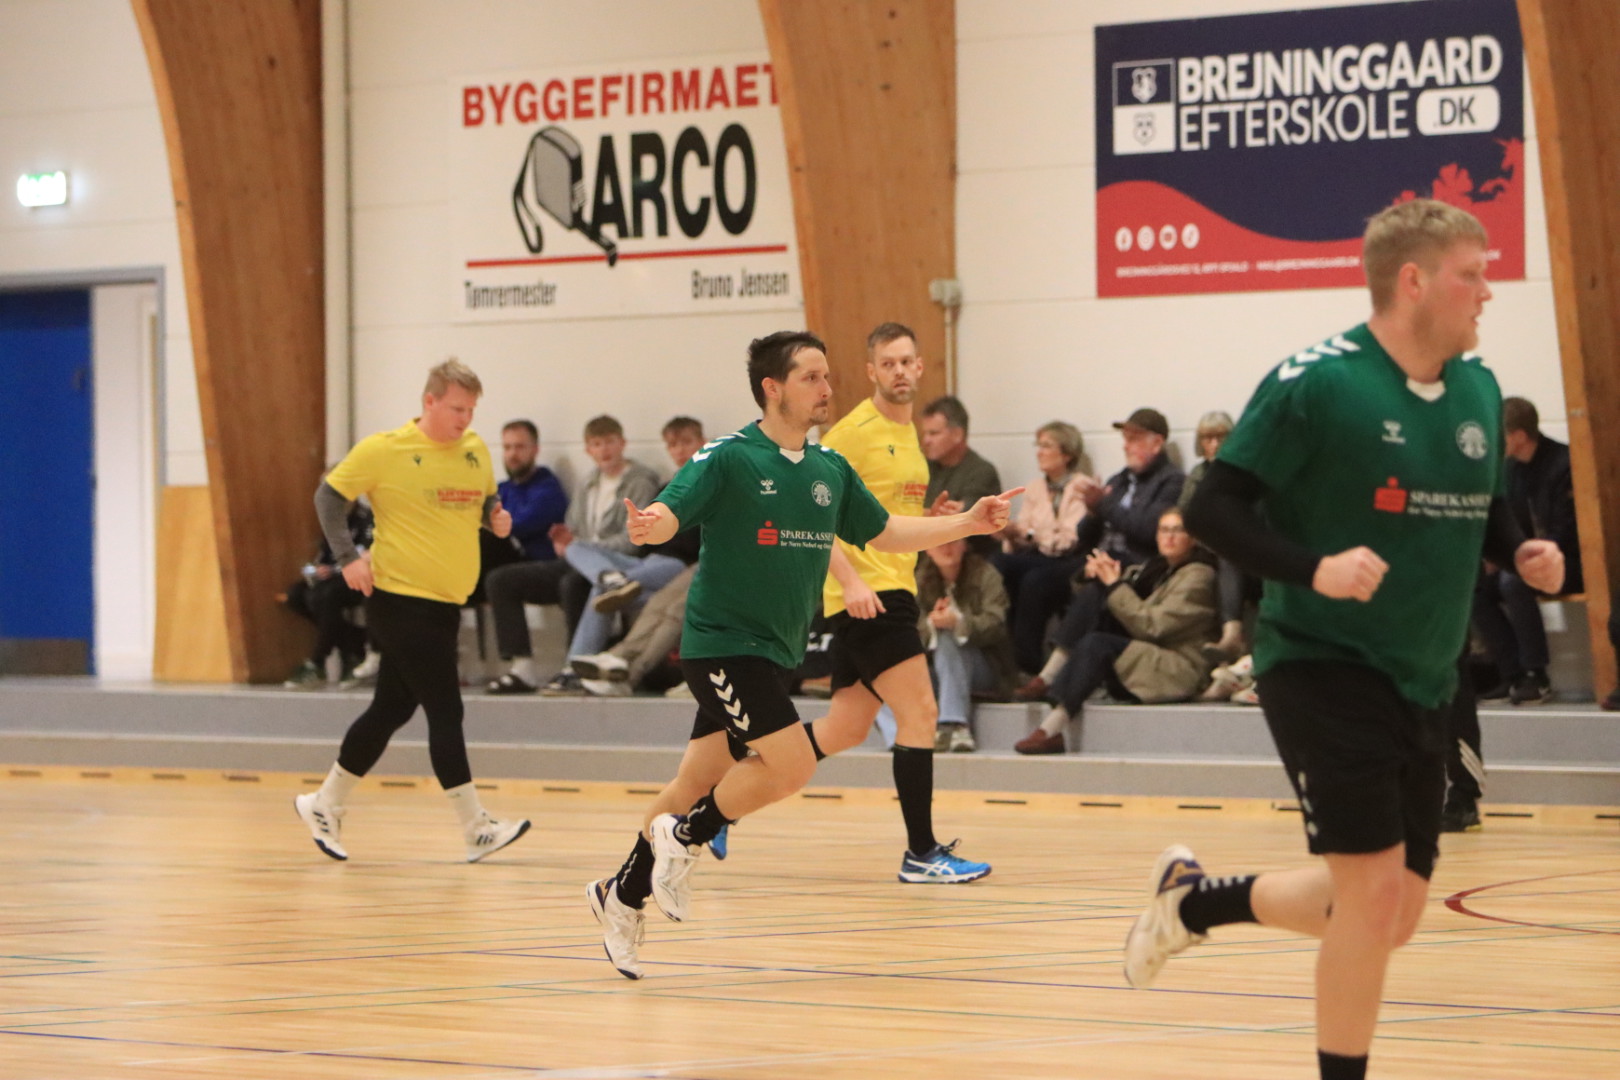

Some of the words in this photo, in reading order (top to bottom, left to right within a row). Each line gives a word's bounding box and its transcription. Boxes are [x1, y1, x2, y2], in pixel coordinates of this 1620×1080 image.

[1178, 35, 1502, 104] BREJNINGGAARD
[1179, 92, 1410, 152] EFTERSKOLE
[591, 122, 757, 239] ARCO
[692, 269, 734, 299] Bruno
[739, 266, 789, 297] Jensen
